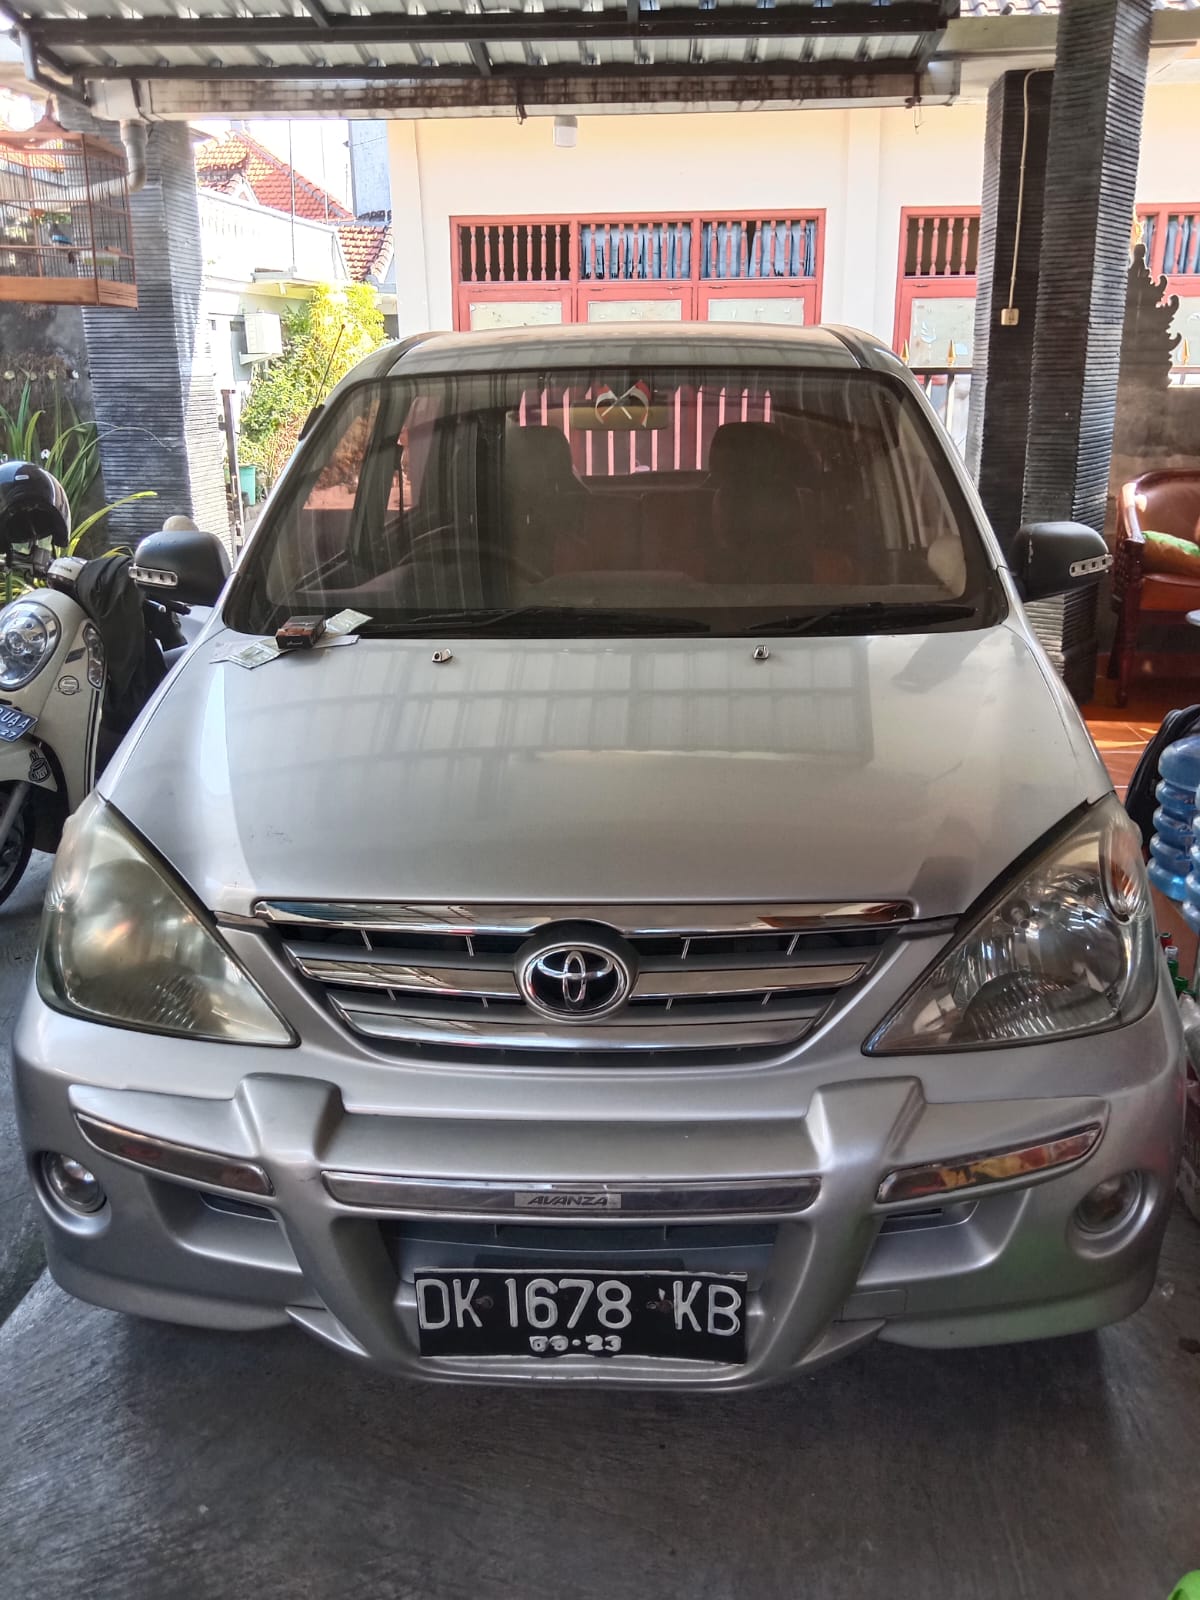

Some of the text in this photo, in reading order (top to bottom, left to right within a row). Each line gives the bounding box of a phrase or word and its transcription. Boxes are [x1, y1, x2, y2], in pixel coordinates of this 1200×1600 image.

[527, 1195, 609, 1207] AVANZA
[415, 1278, 742, 1336] DK 1678 KB
